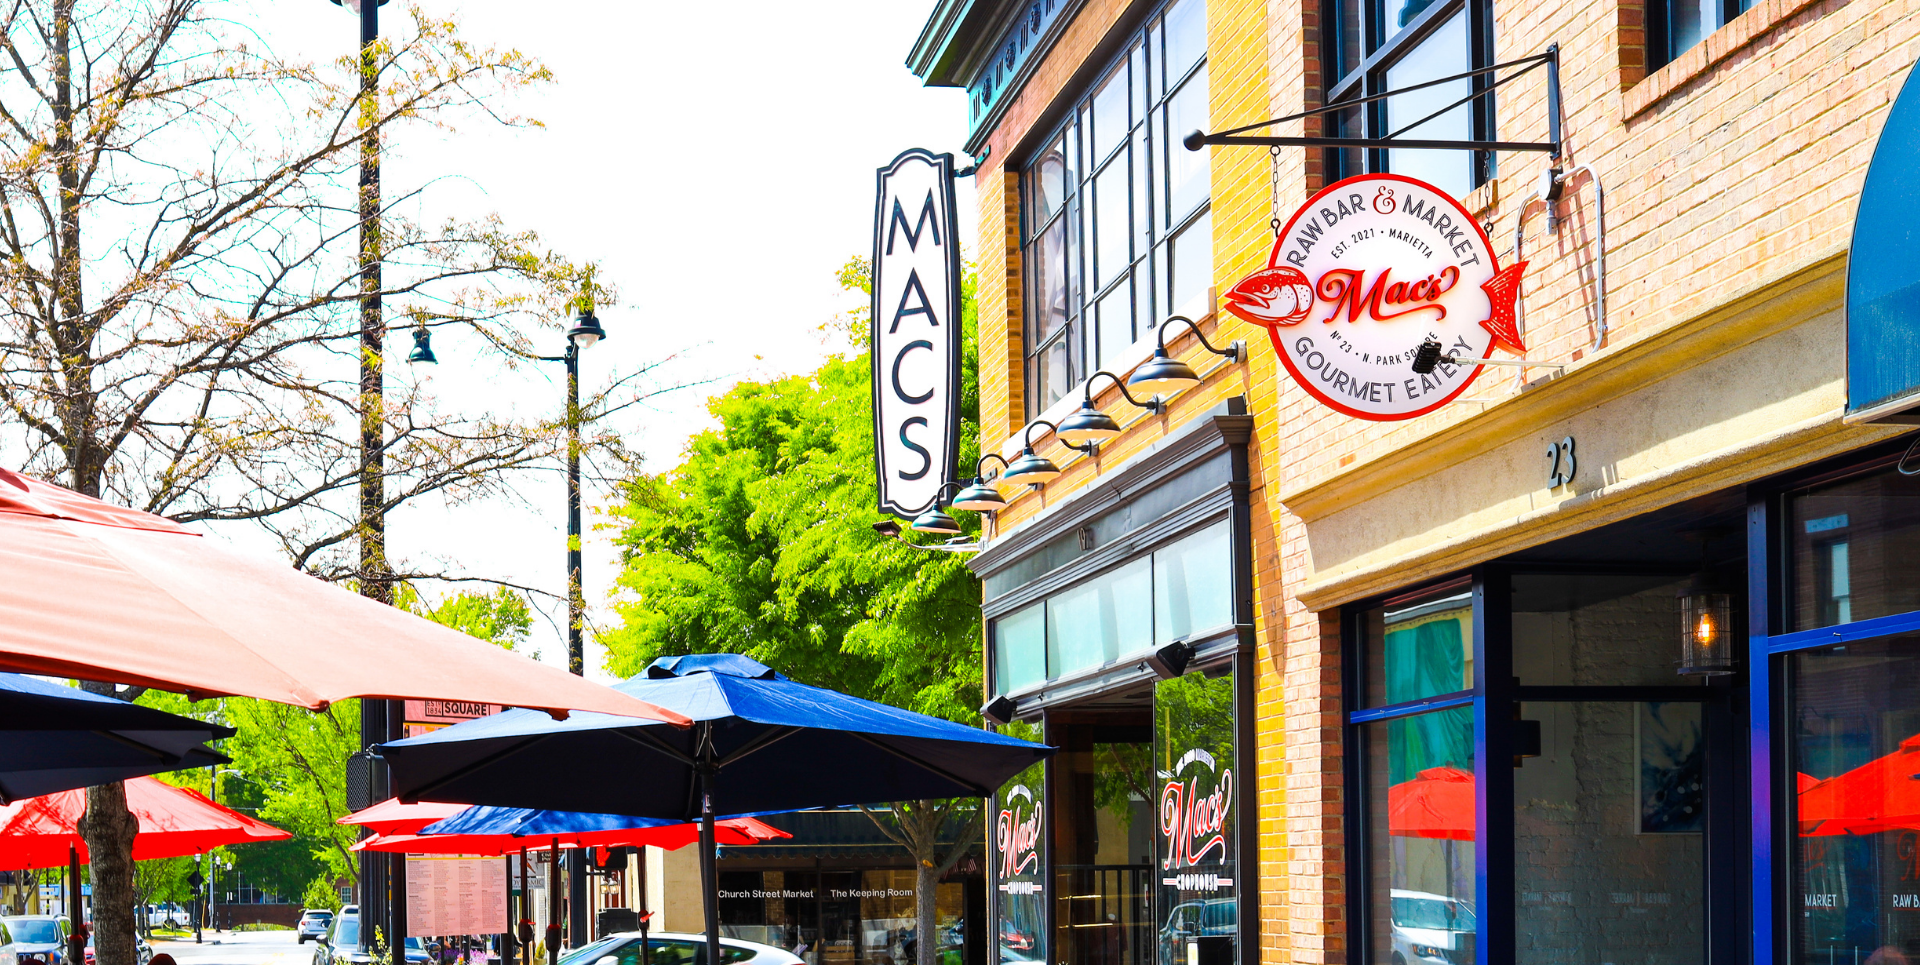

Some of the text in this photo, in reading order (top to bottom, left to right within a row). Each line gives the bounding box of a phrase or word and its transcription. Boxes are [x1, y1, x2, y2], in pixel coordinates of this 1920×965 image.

[1286, 185, 1480, 268] RAW BAR & MARKET
[1330, 228, 1433, 260] EST. 2021 MARIETTA
[1316, 265, 1460, 324] Mac's
[1295, 334, 1473, 403] GOURMET EATERY
[1339, 341, 1352, 354] 23
[1362, 353, 1372, 365] N.
[1376, 355, 1402, 366] PARK
[1546, 436, 1577, 490] 23
[444, 702, 487, 716] SQUARE
[1160, 768, 1233, 871] Mac's
[997, 800, 1043, 880] Mac's
[718, 889, 814, 899] Church Street Market
[830, 888, 913, 899] The Keeping Room
[1804, 894, 1837, 907] MARKET
[1892, 894, 1912, 908] RAW
